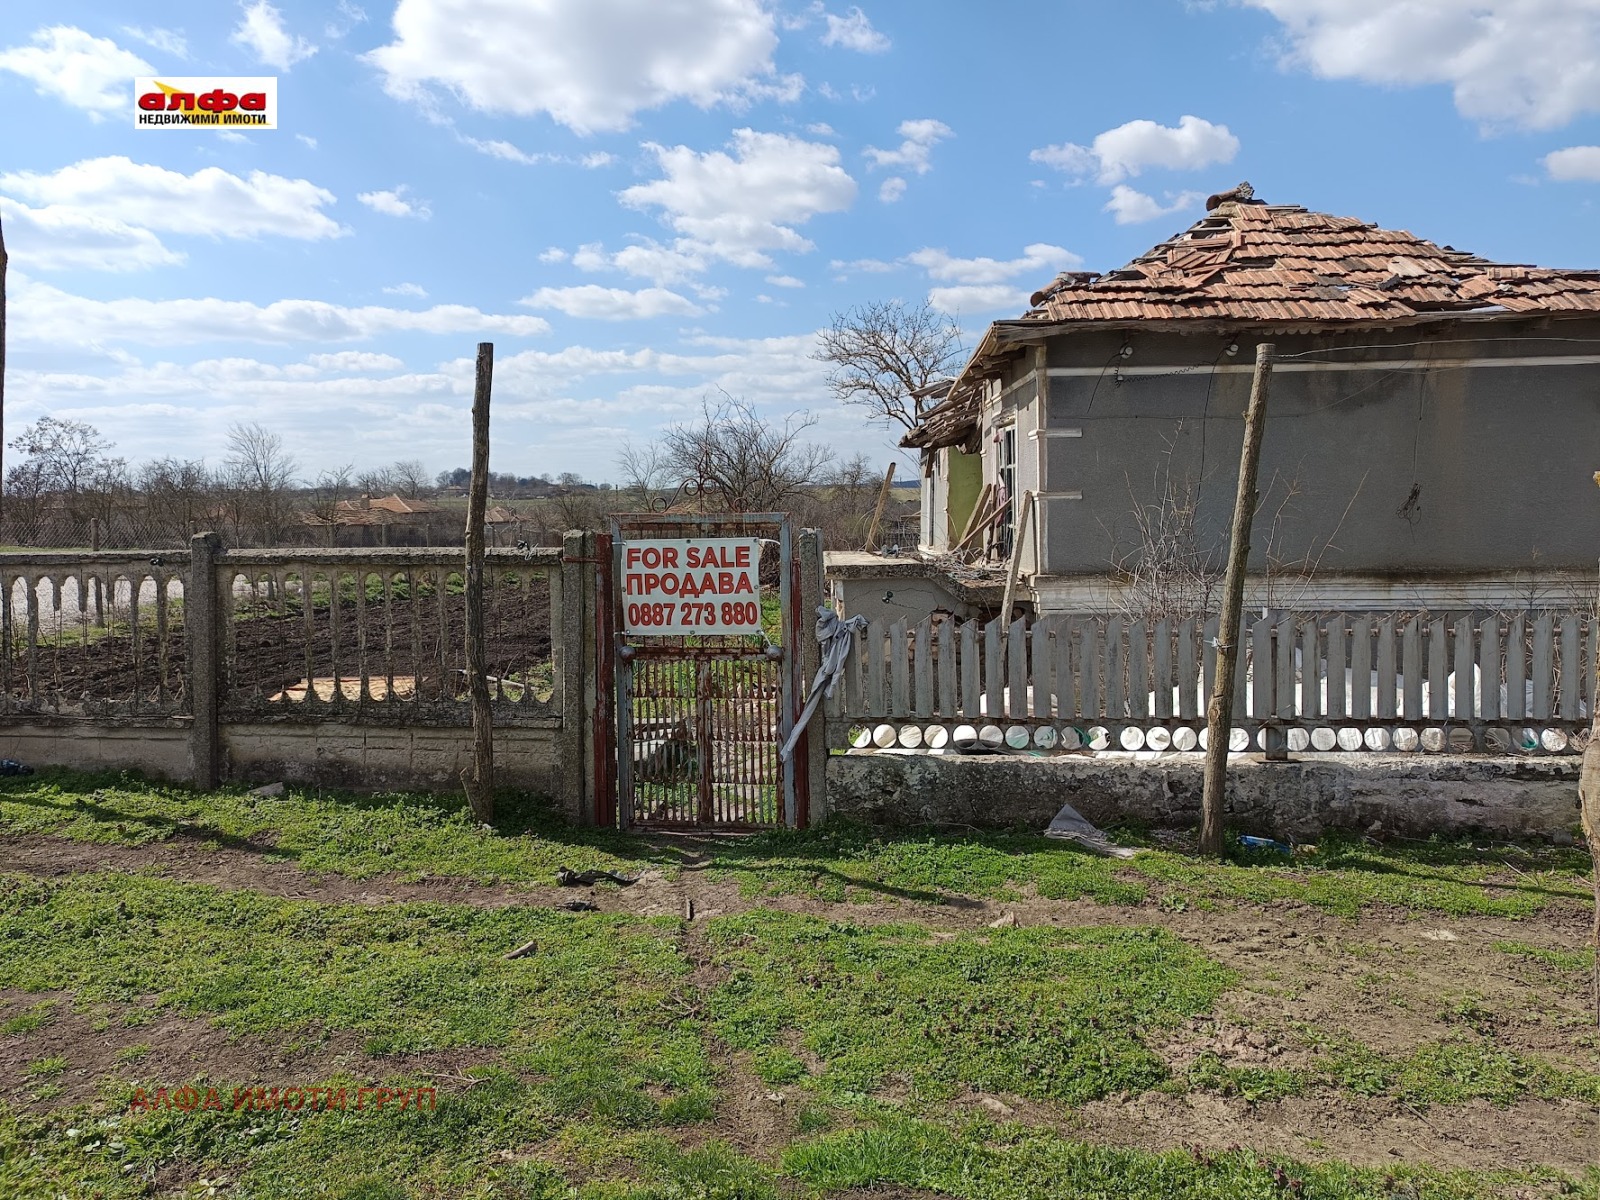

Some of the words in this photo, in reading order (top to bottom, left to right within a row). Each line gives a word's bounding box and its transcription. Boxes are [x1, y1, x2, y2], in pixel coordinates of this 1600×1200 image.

[627, 547, 679, 569] FOR
[686, 546, 751, 568] SALE
[626, 572, 753, 598] ПРОДАВА
[628, 603, 676, 626] 0887
[680, 602, 716, 626] 273
[721, 602, 757, 625] 880
